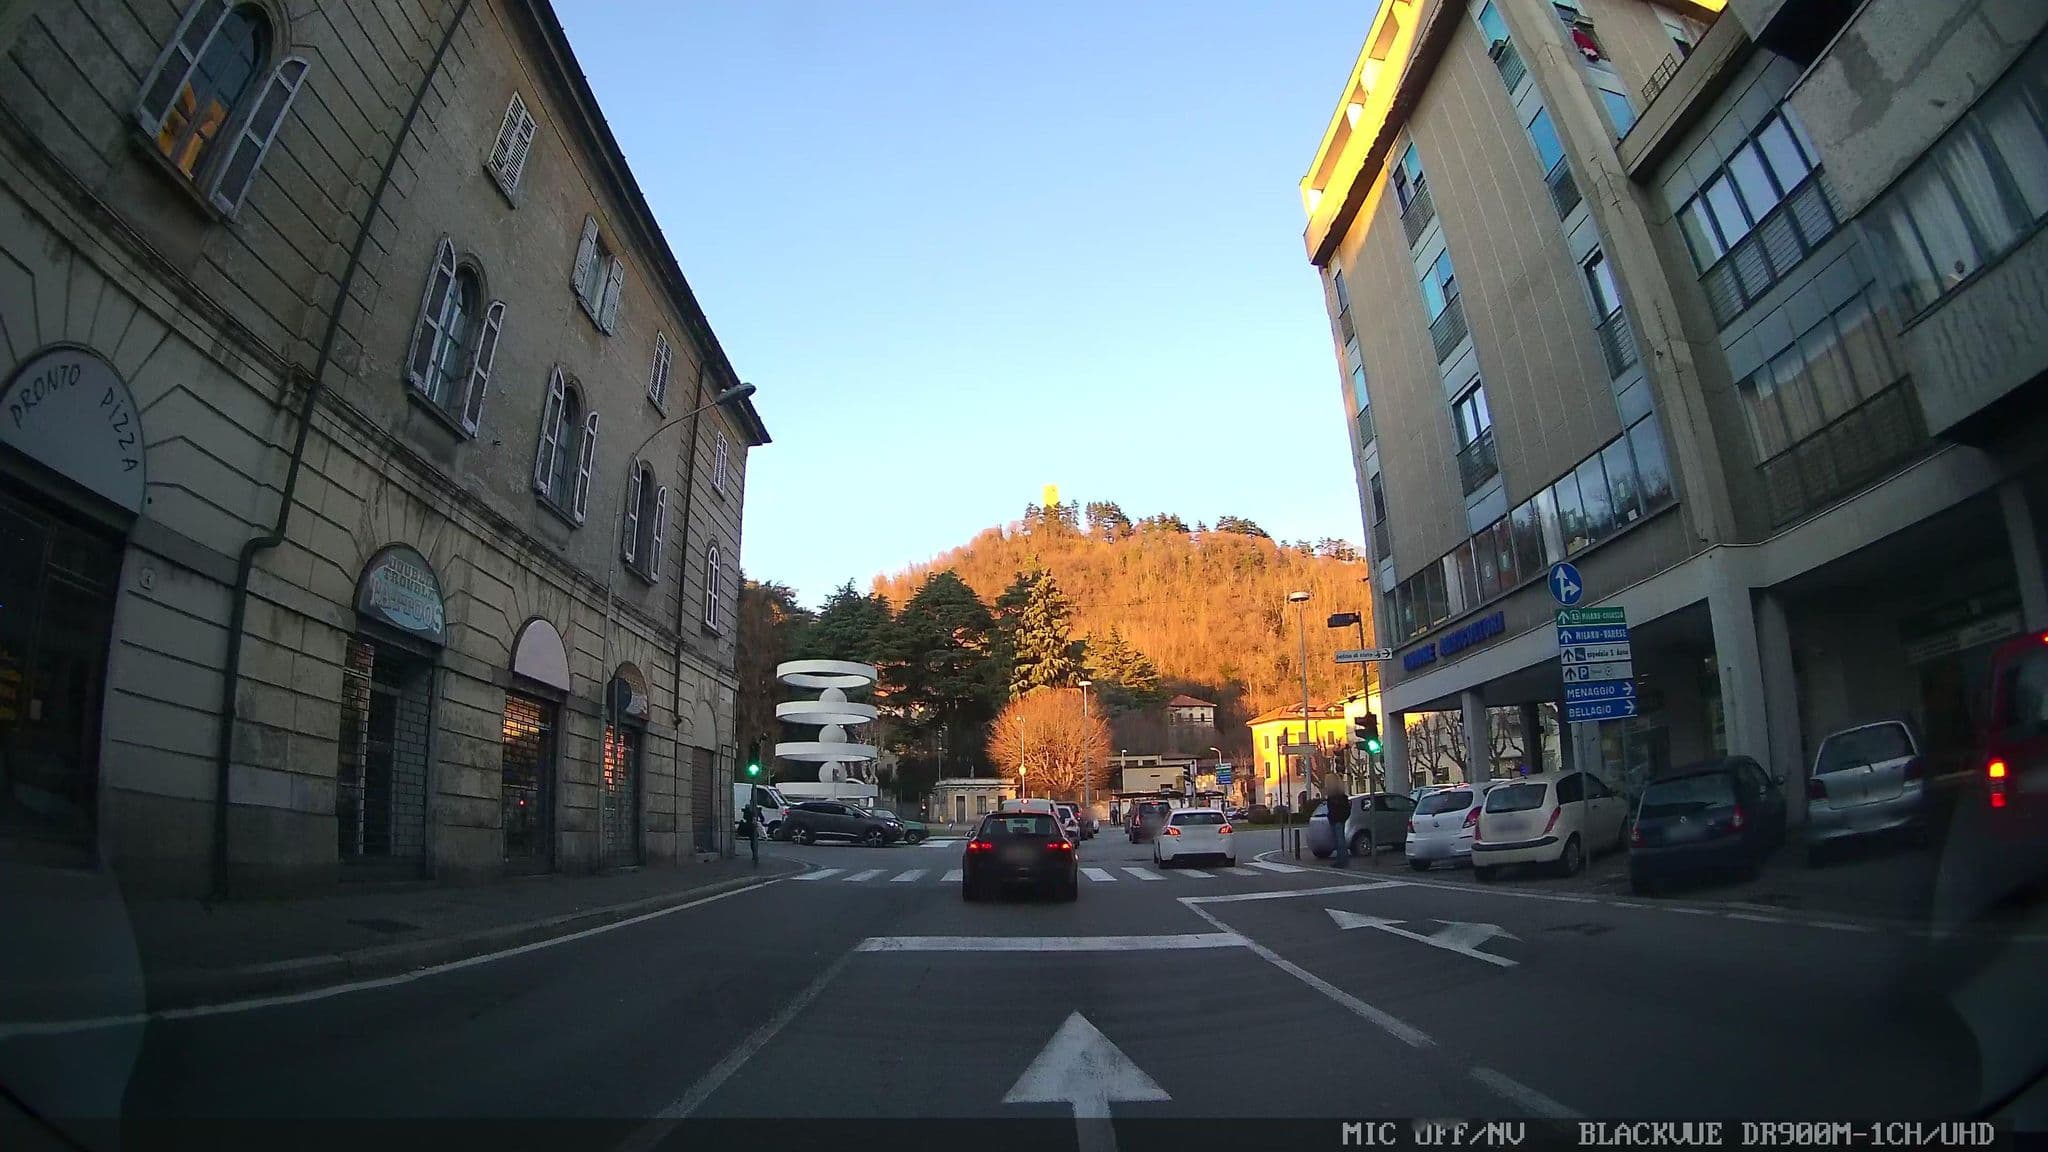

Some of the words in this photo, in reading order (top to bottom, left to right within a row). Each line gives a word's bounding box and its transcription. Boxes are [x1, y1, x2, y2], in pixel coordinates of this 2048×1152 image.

[9, 364, 82, 430] PRONTO
[384, 566, 435, 602] TROUBLE
[1580, 667, 1588, 679] P
[1567, 686, 1615, 698] MENAGGIO
[1569, 705, 1612, 718] BELLAGIO
